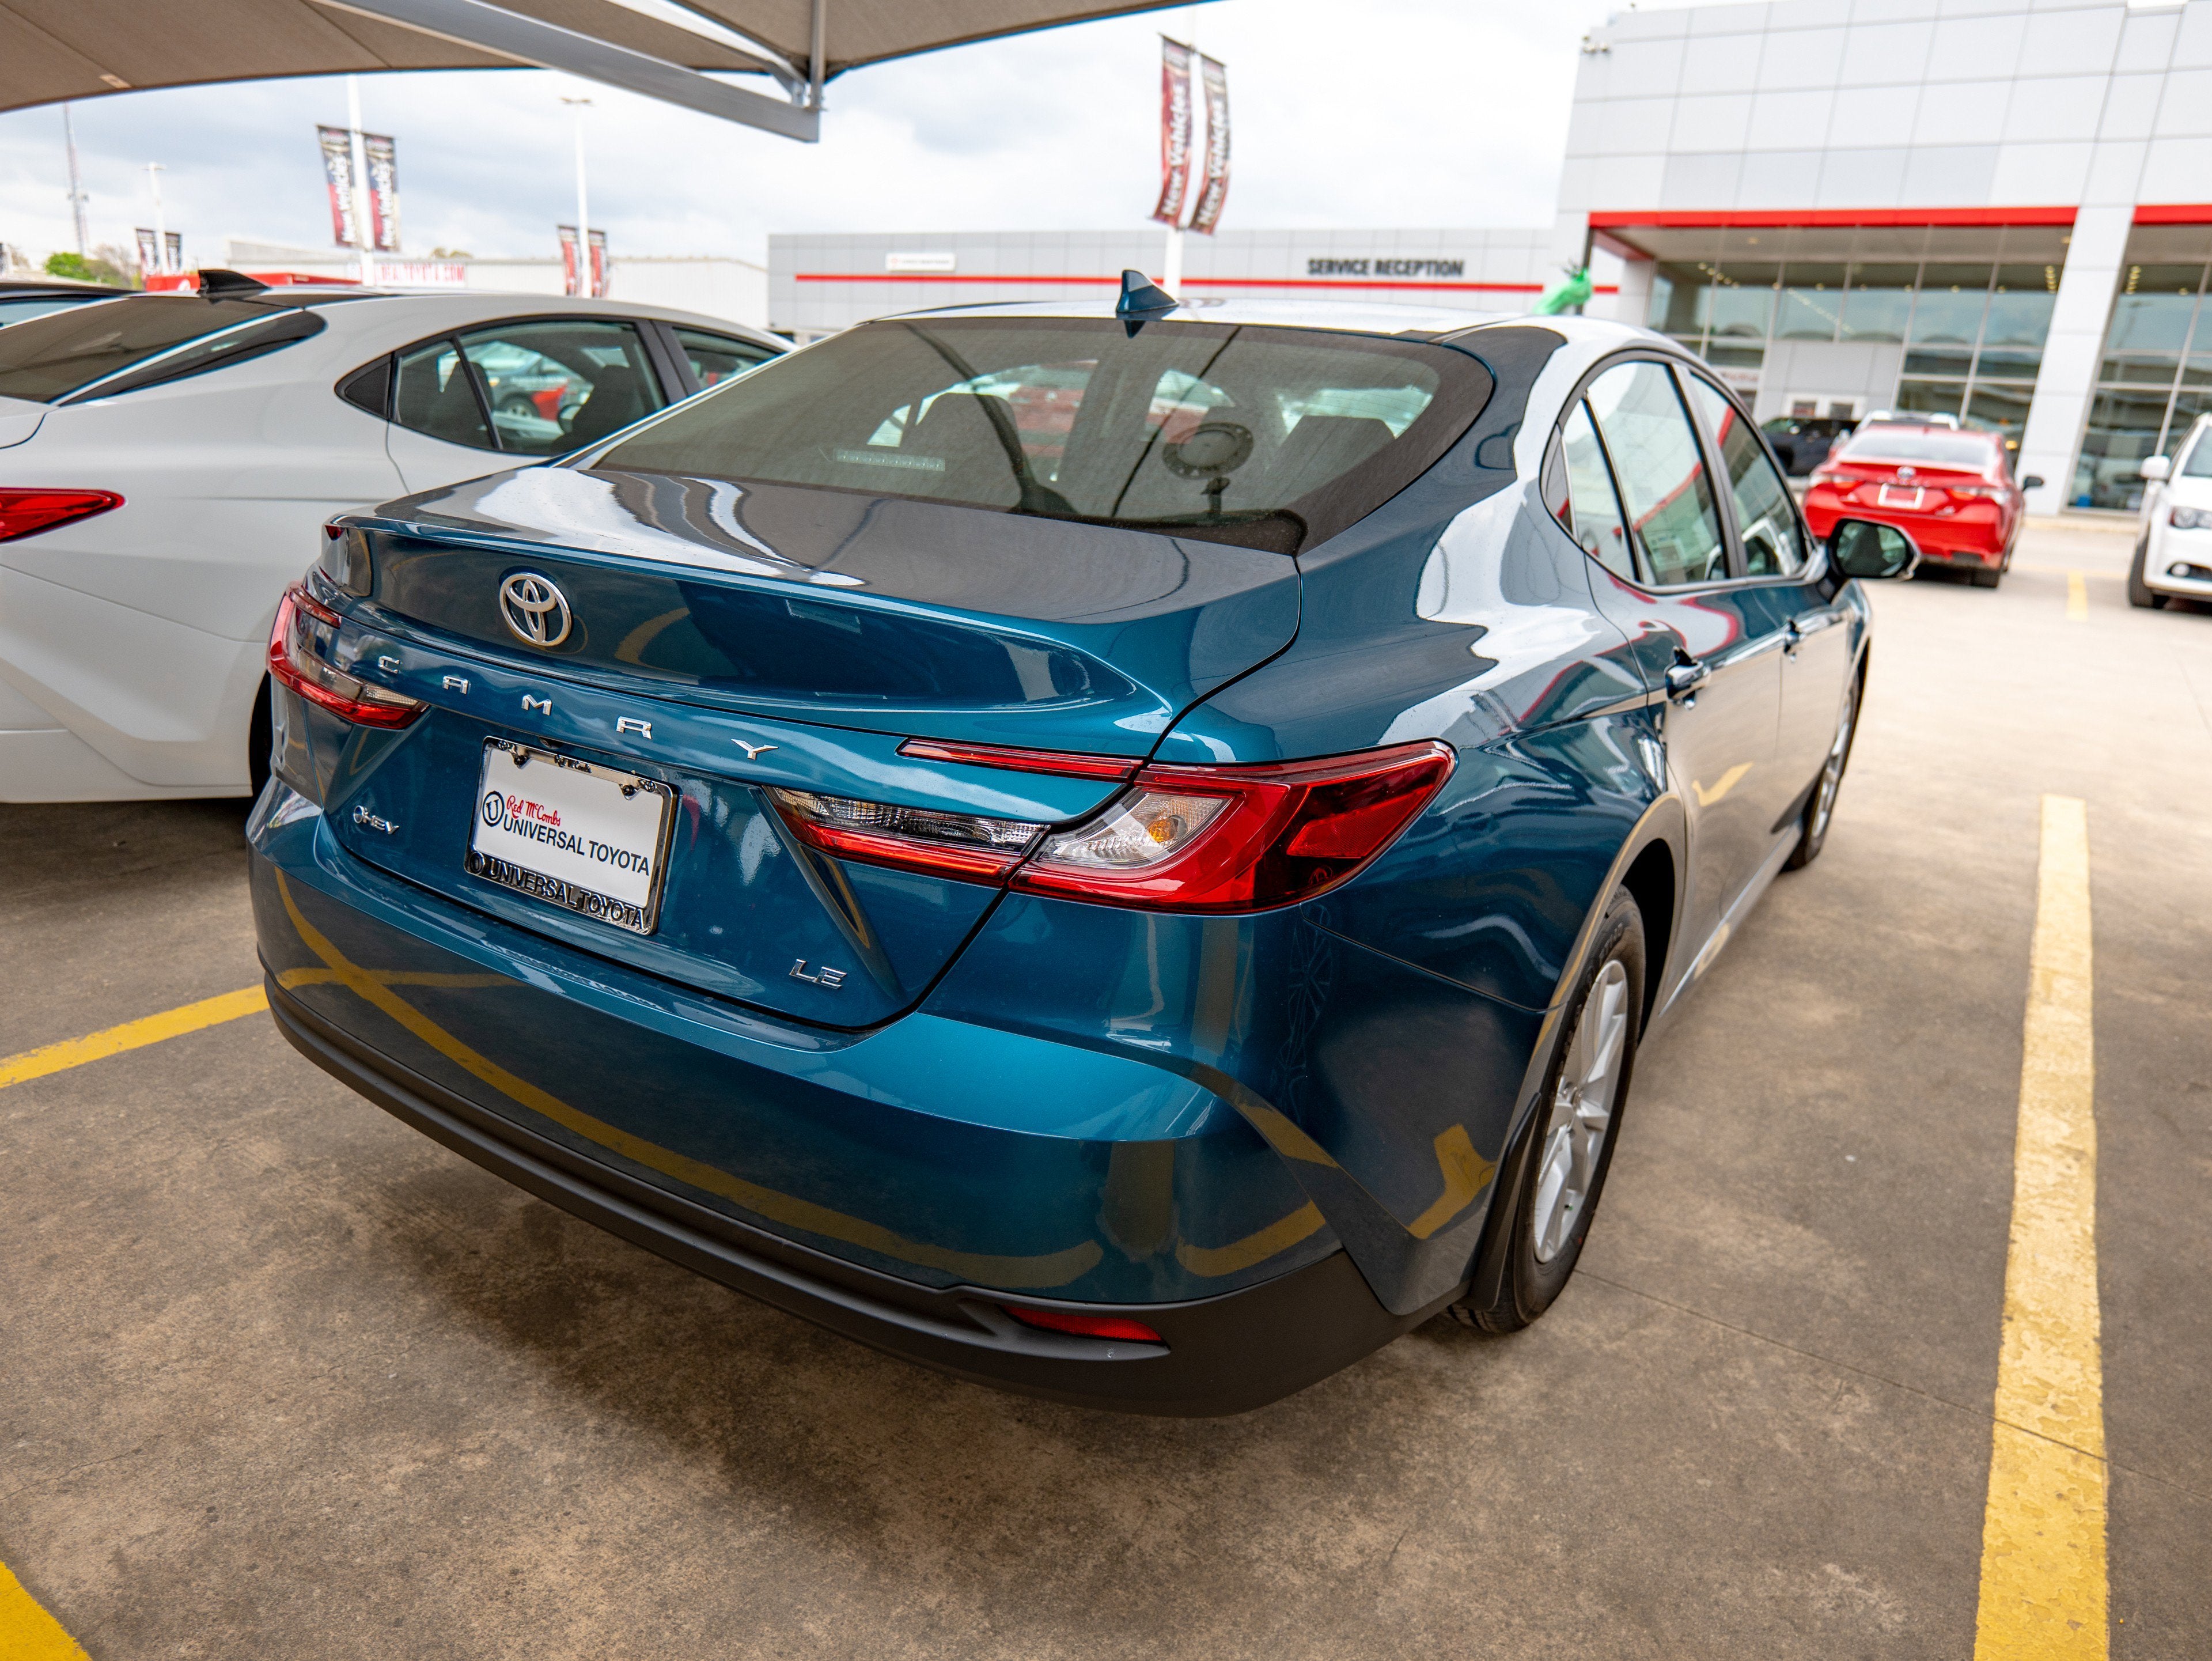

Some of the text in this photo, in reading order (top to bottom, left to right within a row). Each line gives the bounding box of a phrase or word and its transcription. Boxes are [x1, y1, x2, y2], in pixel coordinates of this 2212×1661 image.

[1307, 258, 1465, 277] SERVICE RECEPTION
[378, 655, 779, 760] CAMRY
[506, 795, 561, 827] Red McCombs
[503, 814, 650, 876] UNIVERSAL TOYOTA
[489, 857, 645, 930] UNIVERSAL TOYOTA
[789, 958, 847, 989] LE
